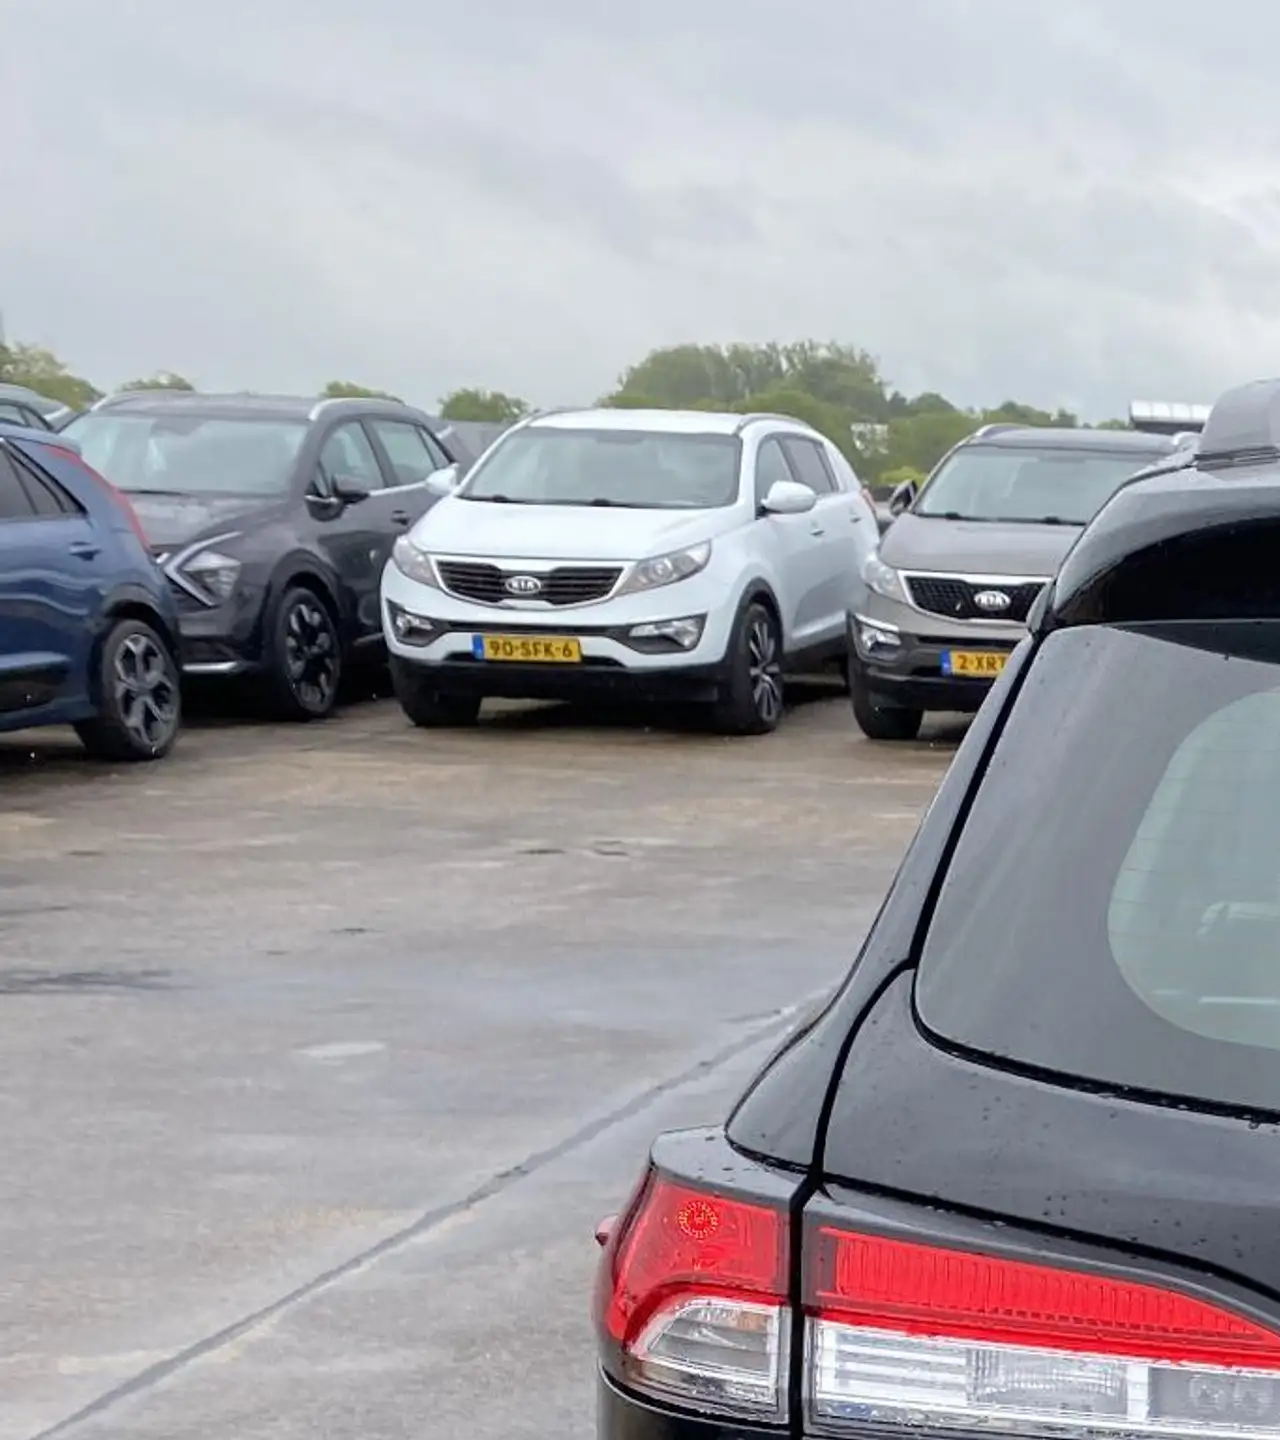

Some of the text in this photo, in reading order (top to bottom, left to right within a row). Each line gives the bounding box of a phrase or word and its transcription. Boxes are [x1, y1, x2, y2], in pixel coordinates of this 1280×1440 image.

[507, 579, 538, 593] KIA
[976, 594, 1008, 607] KIA
[489, 641, 573, 657] 90-SFK-6
